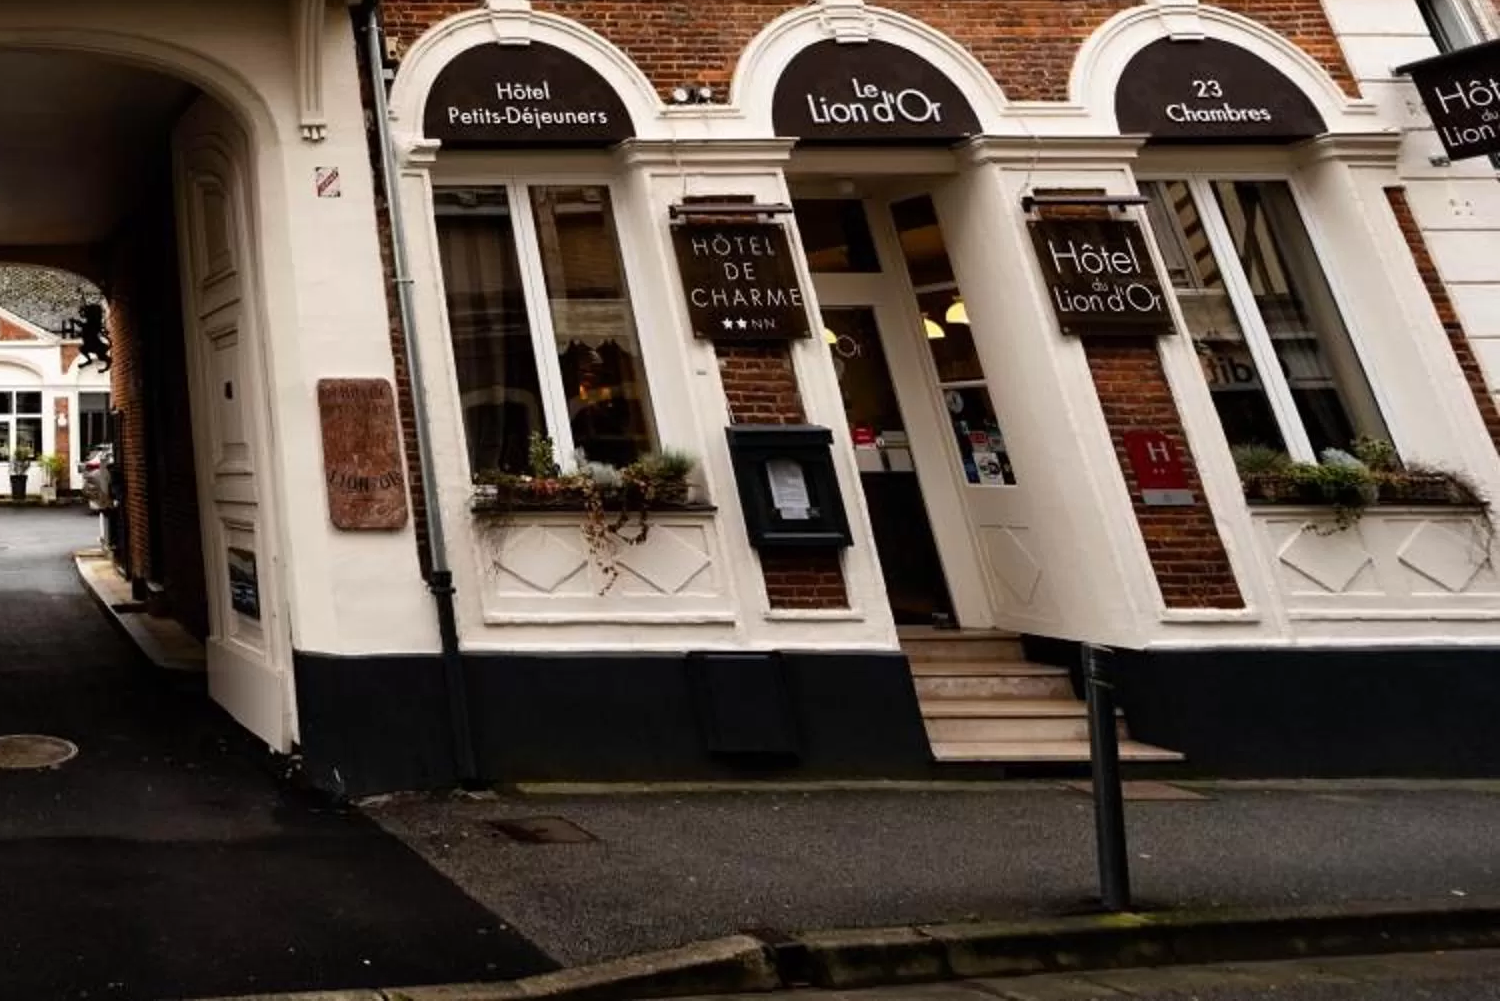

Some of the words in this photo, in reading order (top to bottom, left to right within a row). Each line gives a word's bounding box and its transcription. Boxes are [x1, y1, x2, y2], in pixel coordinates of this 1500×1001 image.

[495, 80, 550, 101] Hôtel
[851, 77, 879, 99] Le
[1192, 80, 1223, 99] 23
[807, 93, 869, 123] Lion
[873, 88, 941, 123] d'Or
[1165, 104, 1272, 122] Chambres
[447, 106, 608, 129] Petits-Déjeuners
[1442, 125, 1497, 147] Lion
[691, 233, 776, 256] HÔTEL
[1047, 236, 1141, 274] Hôtel
[724, 262, 756, 280] DE
[1091, 278, 1108, 292] du
[691, 287, 802, 308] CHARME
[1053, 286, 1105, 313] Lion
[1107, 283, 1163, 313] d'Or
[751, 318, 776, 330] NN
[1146, 441, 1171, 463] H
